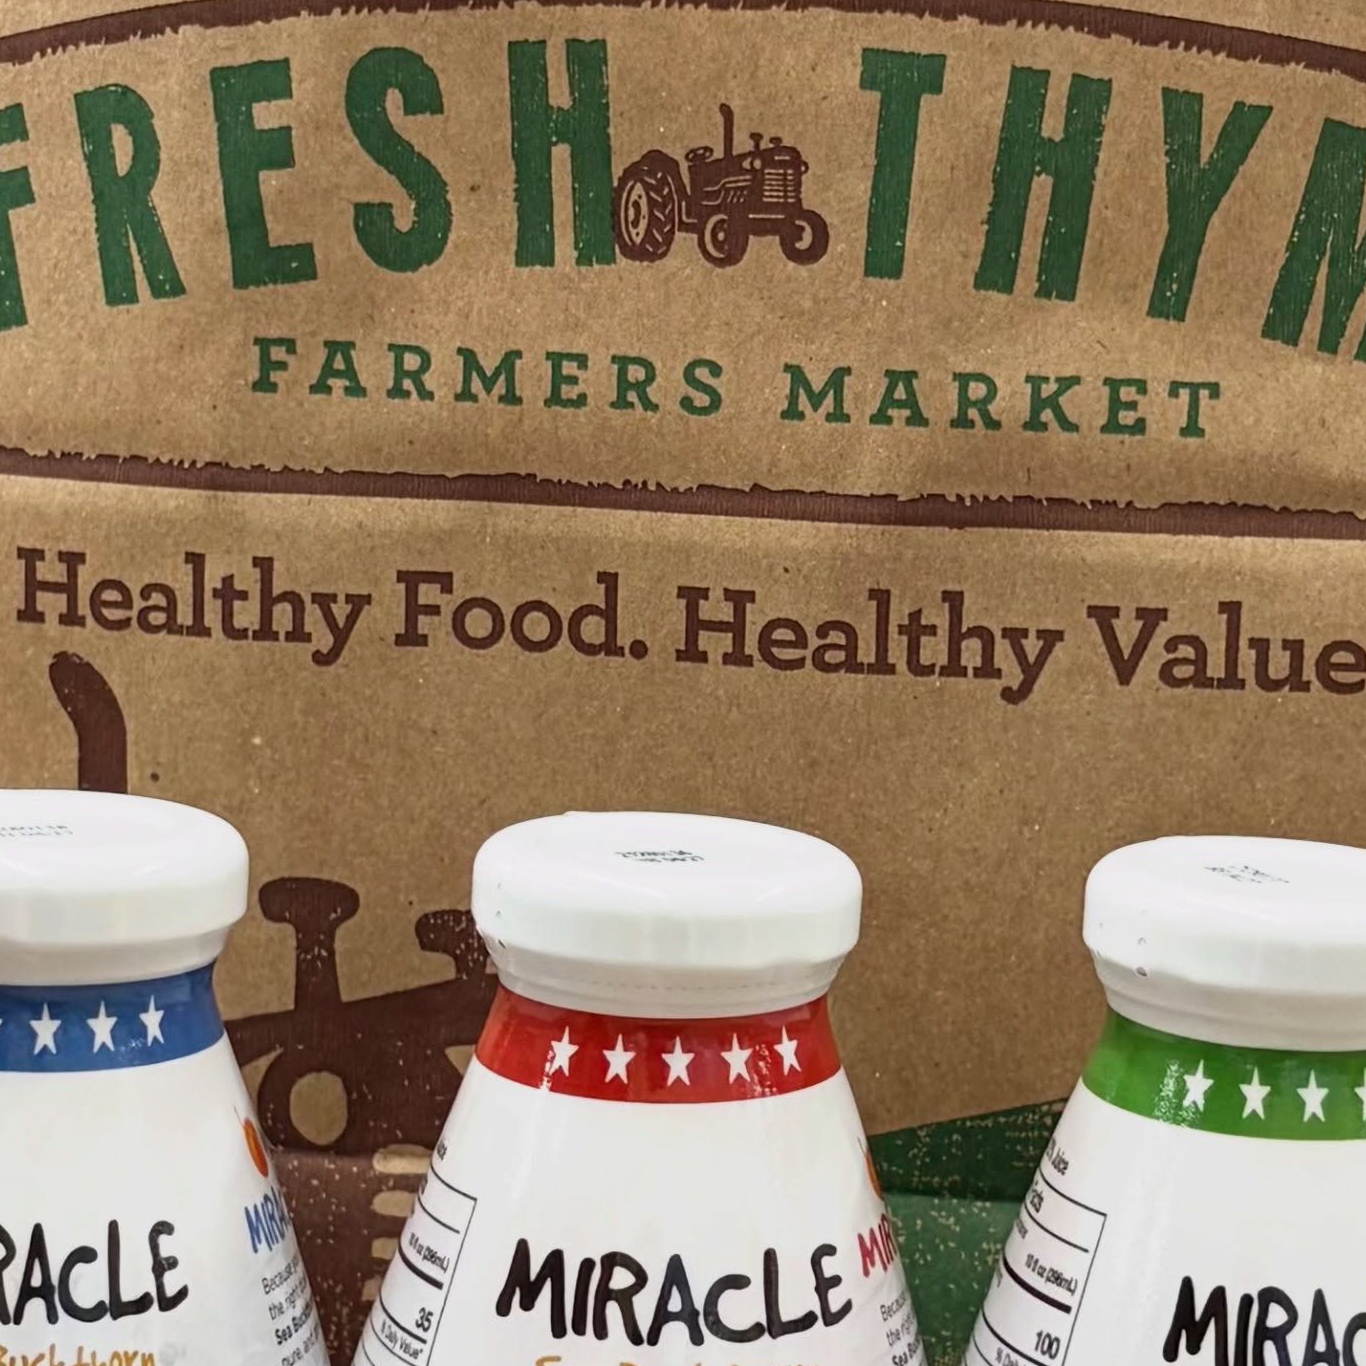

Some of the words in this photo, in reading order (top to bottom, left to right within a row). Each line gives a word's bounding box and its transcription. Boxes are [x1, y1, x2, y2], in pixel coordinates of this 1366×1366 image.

[251, 337, 726, 417] FARMERS
[780, 362, 1221, 438] MARKET
[16, 547, 372, 667] Healthy
[394, 571, 650, 661] Food.
[675, 585, 1063, 706] Healthy
[268, 1296, 285, 1321] the
[495, 1239, 854, 1348] MIRACLE
[275, 1324, 293, 1346] Sea
[415, 1306, 434, 1333] 35
[1034, 1328, 1061, 1360] 100
